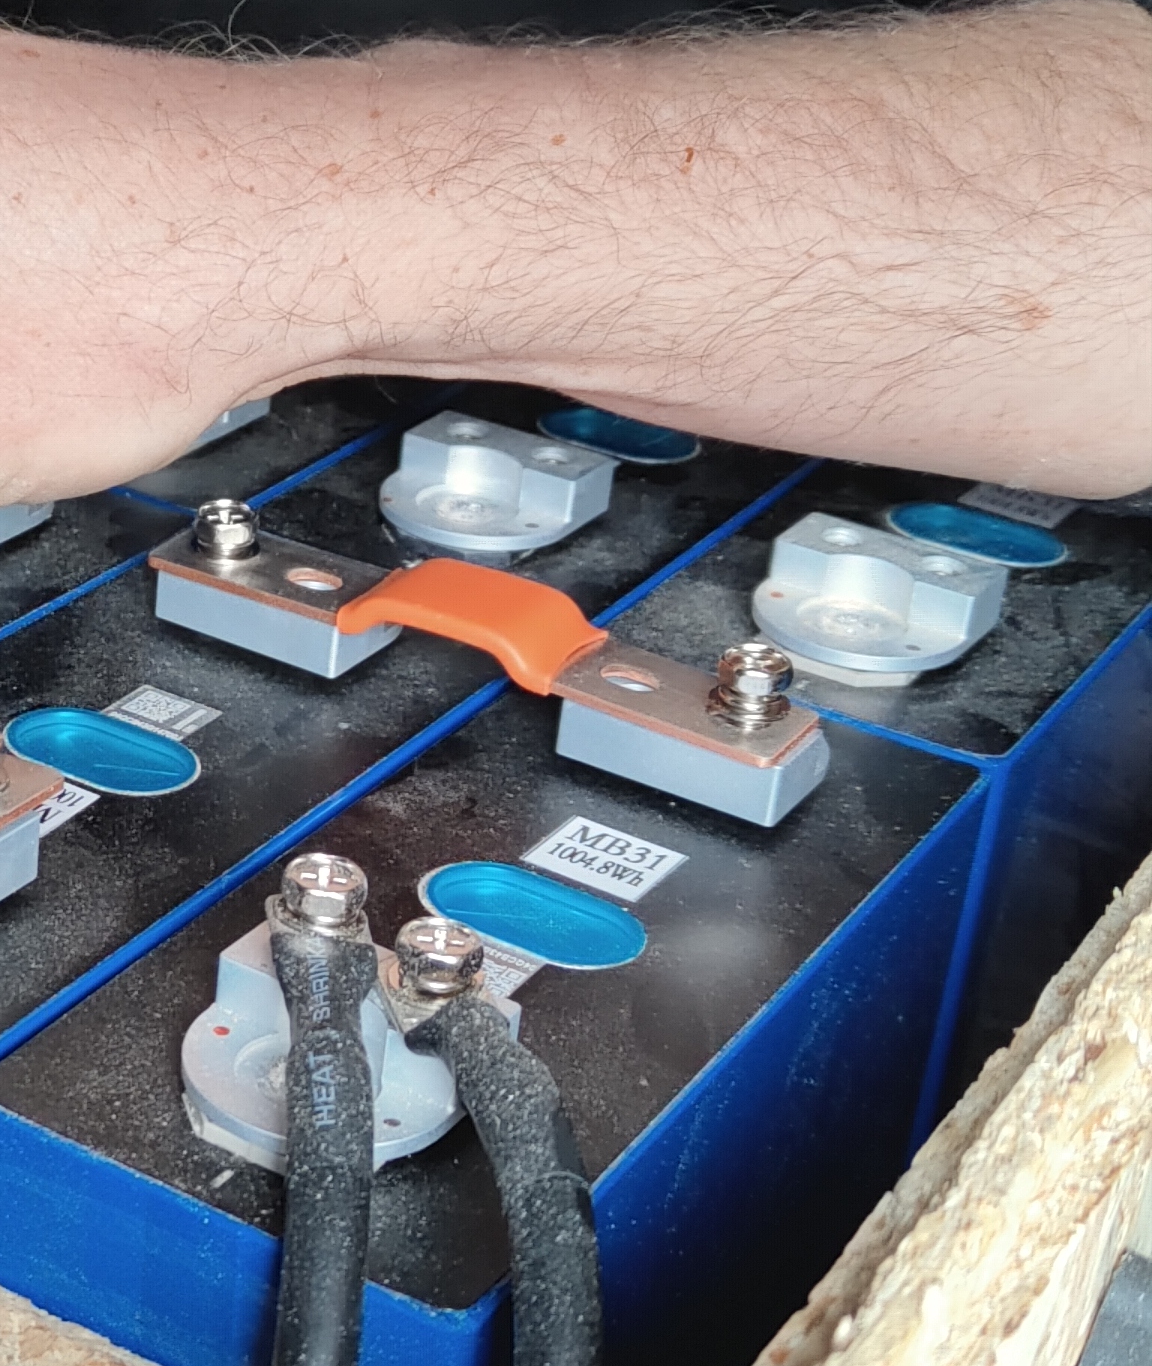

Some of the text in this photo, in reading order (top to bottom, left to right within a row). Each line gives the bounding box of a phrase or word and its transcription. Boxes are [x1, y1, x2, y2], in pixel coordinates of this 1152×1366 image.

[546, 842, 645, 887] 1004.8Wh
[565, 824, 669, 871] MB31
[307, 1050, 337, 1129] HEAT
